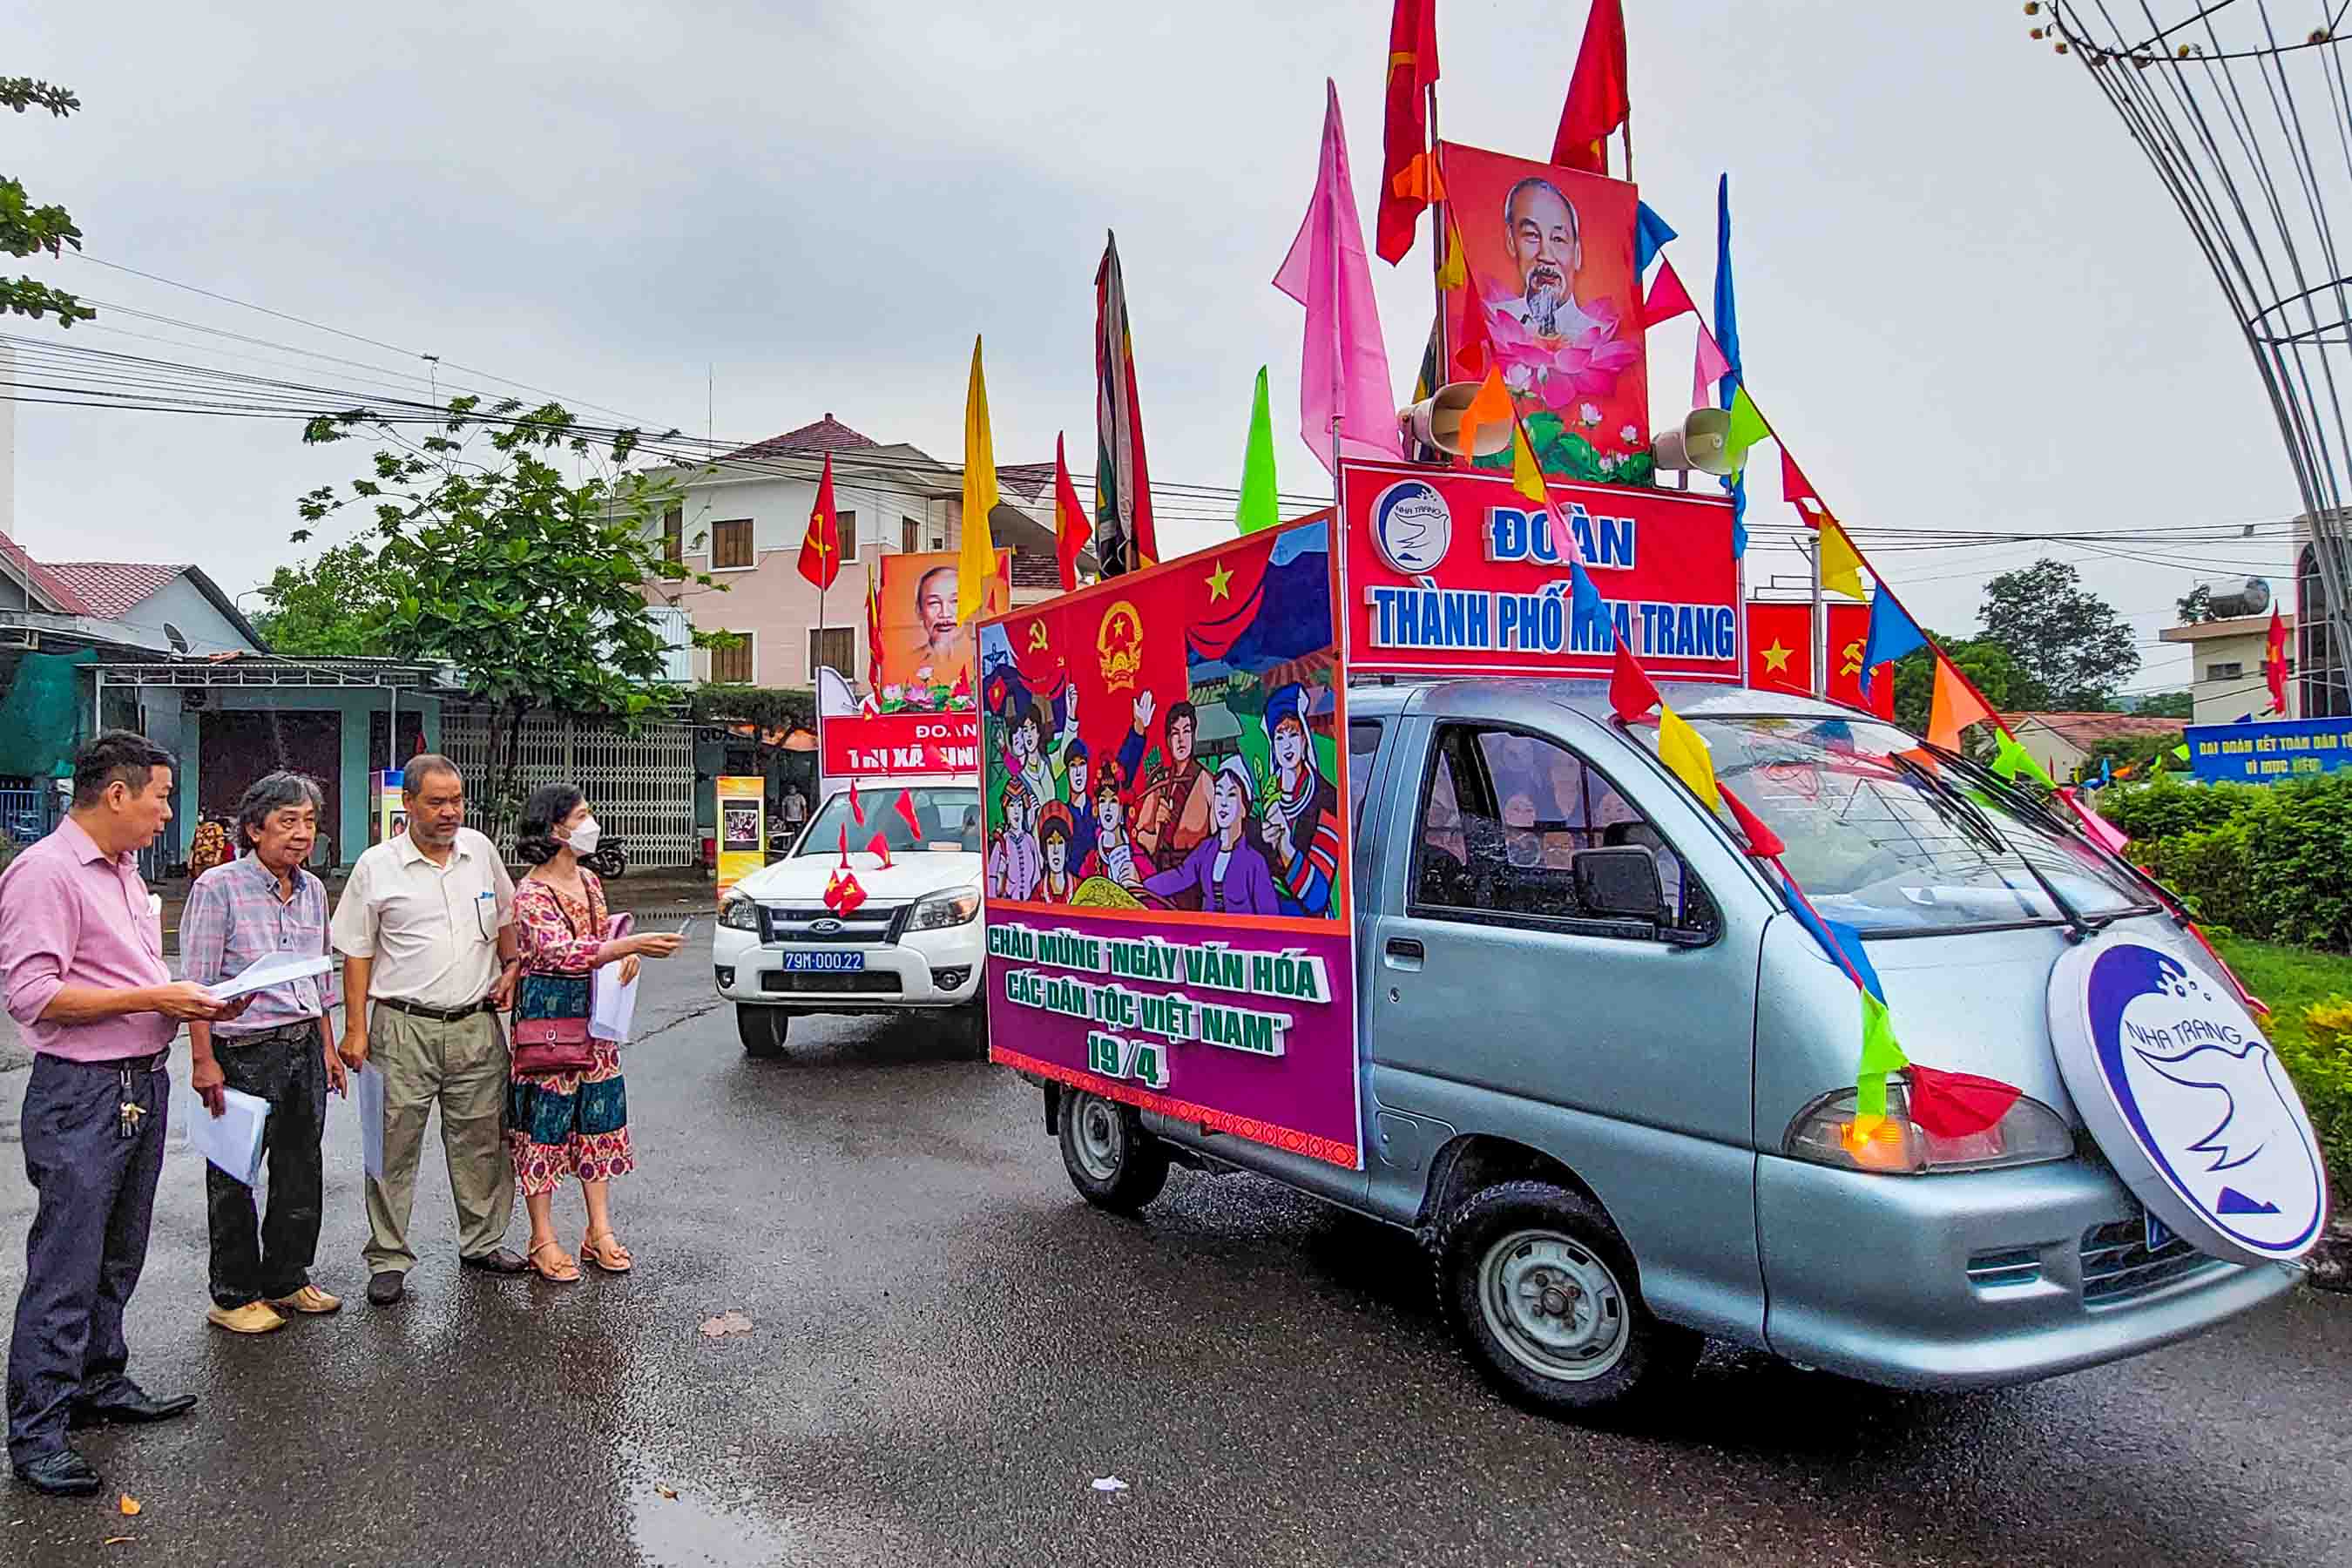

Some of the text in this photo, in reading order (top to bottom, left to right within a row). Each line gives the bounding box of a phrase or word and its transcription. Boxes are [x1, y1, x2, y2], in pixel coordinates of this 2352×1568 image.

[1396, 505, 1442, 516] NHA TRANG
[1492, 503, 1635, 570] ĐOÀN
[1373, 576, 1491, 649] THÀNH
[1497, 580, 1571, 653] PHỐ
[1639, 602, 1736, 660] TRANG
[893, 743, 925, 767] XÃ
[988, 924, 1034, 962] CHÀO
[1037, 931, 1101, 971] MỪNG
[1185, 943, 1245, 992] VĂN
[1252, 950, 1320, 1000] HÓA
[1006, 970, 1042, 1005] CÁC
[1045, 977, 1086, 1016] DÂN
[1092, 985, 1135, 1030] TỘC
[1139, 993, 1193, 1043] VIỆT
[2125, 1019, 2242, 1050] NHA TRANG
[1088, 1032, 1160, 1086] 19/4
